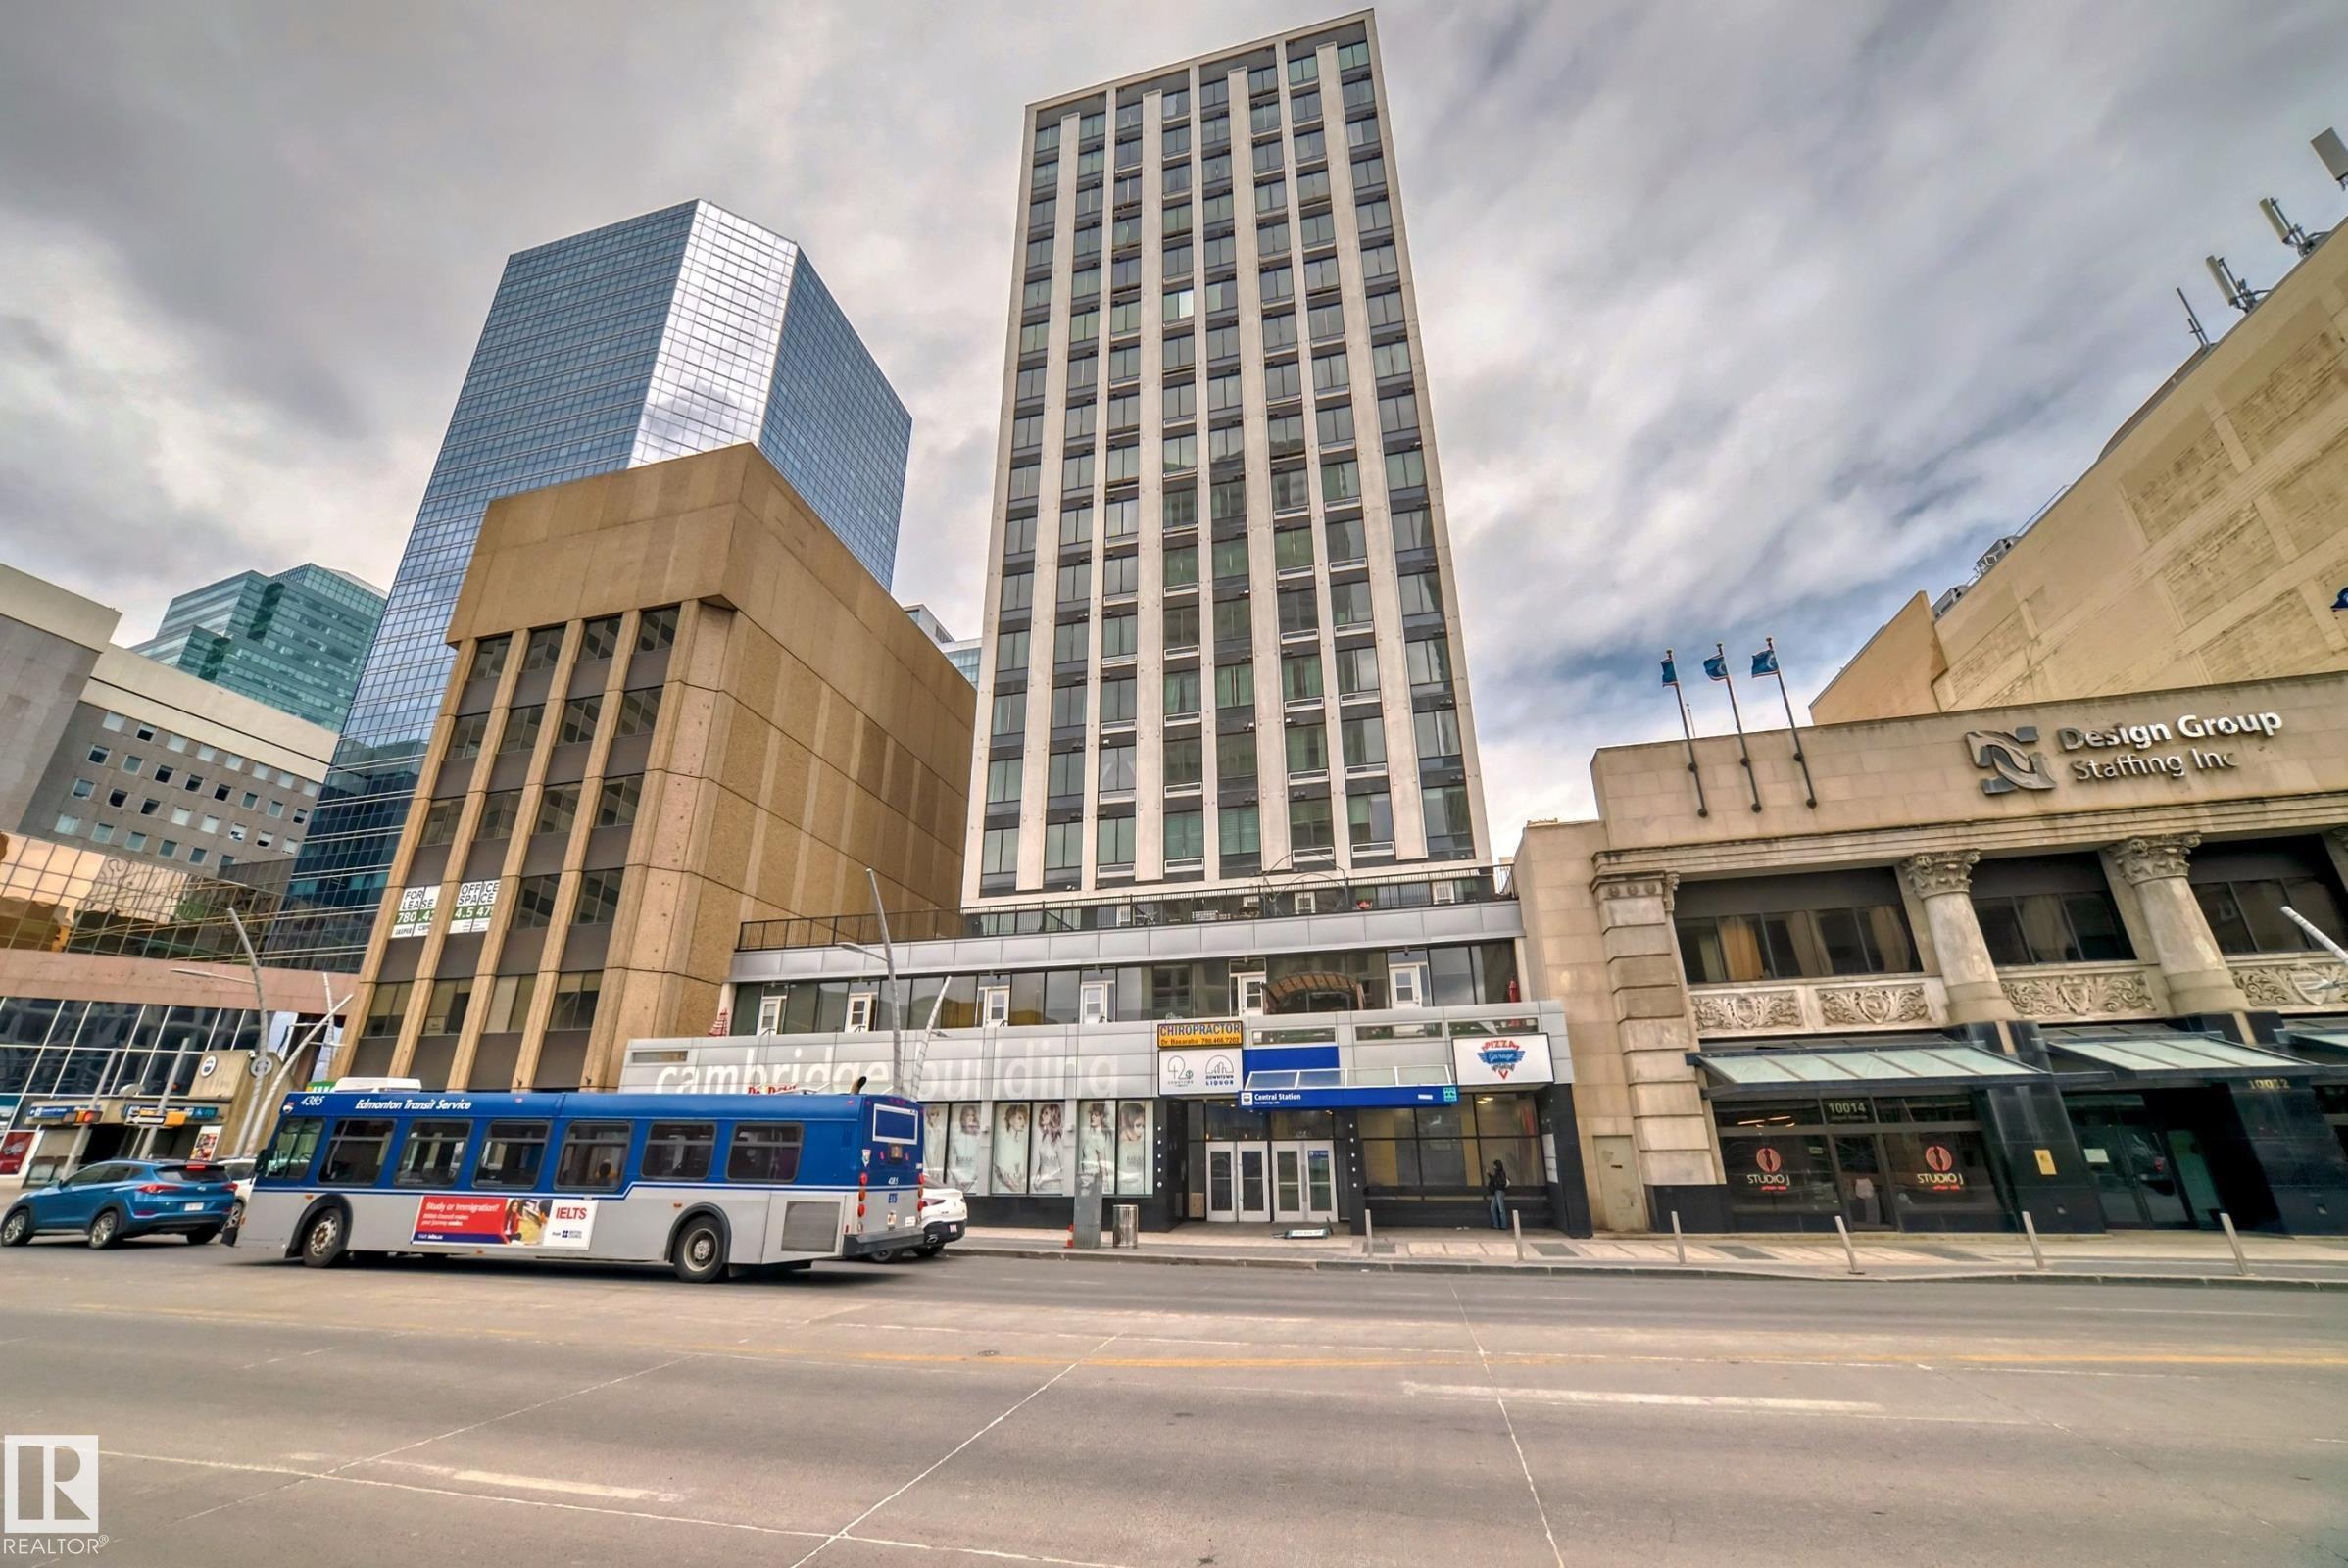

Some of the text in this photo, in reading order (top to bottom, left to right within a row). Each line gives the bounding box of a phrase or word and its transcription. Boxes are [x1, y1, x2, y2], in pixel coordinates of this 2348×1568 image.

[2059, 711, 2283, 750] Design Group
[2071, 747, 2240, 781] Staffing Inc
[462, 882, 500, 895] OFFICE
[405, 890, 424, 900] FOR
[458, 893, 494, 905] SPACE
[402, 899, 434, 910] LEASE
[1160, 1023, 1240, 1036] CHIROPRACTOR
[1484, 1040, 1517, 1050] PIZZA
[301, 1095, 325, 1106] 4385
[1278, 1092, 1301, 1101] Station
[355, 1099, 471, 1110] Edmonton Transit Service
[1828, 1102, 1867, 1114] 10014
[1746, 1174, 1791, 1186] STUDIO J
[1917, 1172, 1964, 1185] STUDIO J
[425, 1201, 446, 1212] Study
[555, 1207, 587, 1220] IELTS
